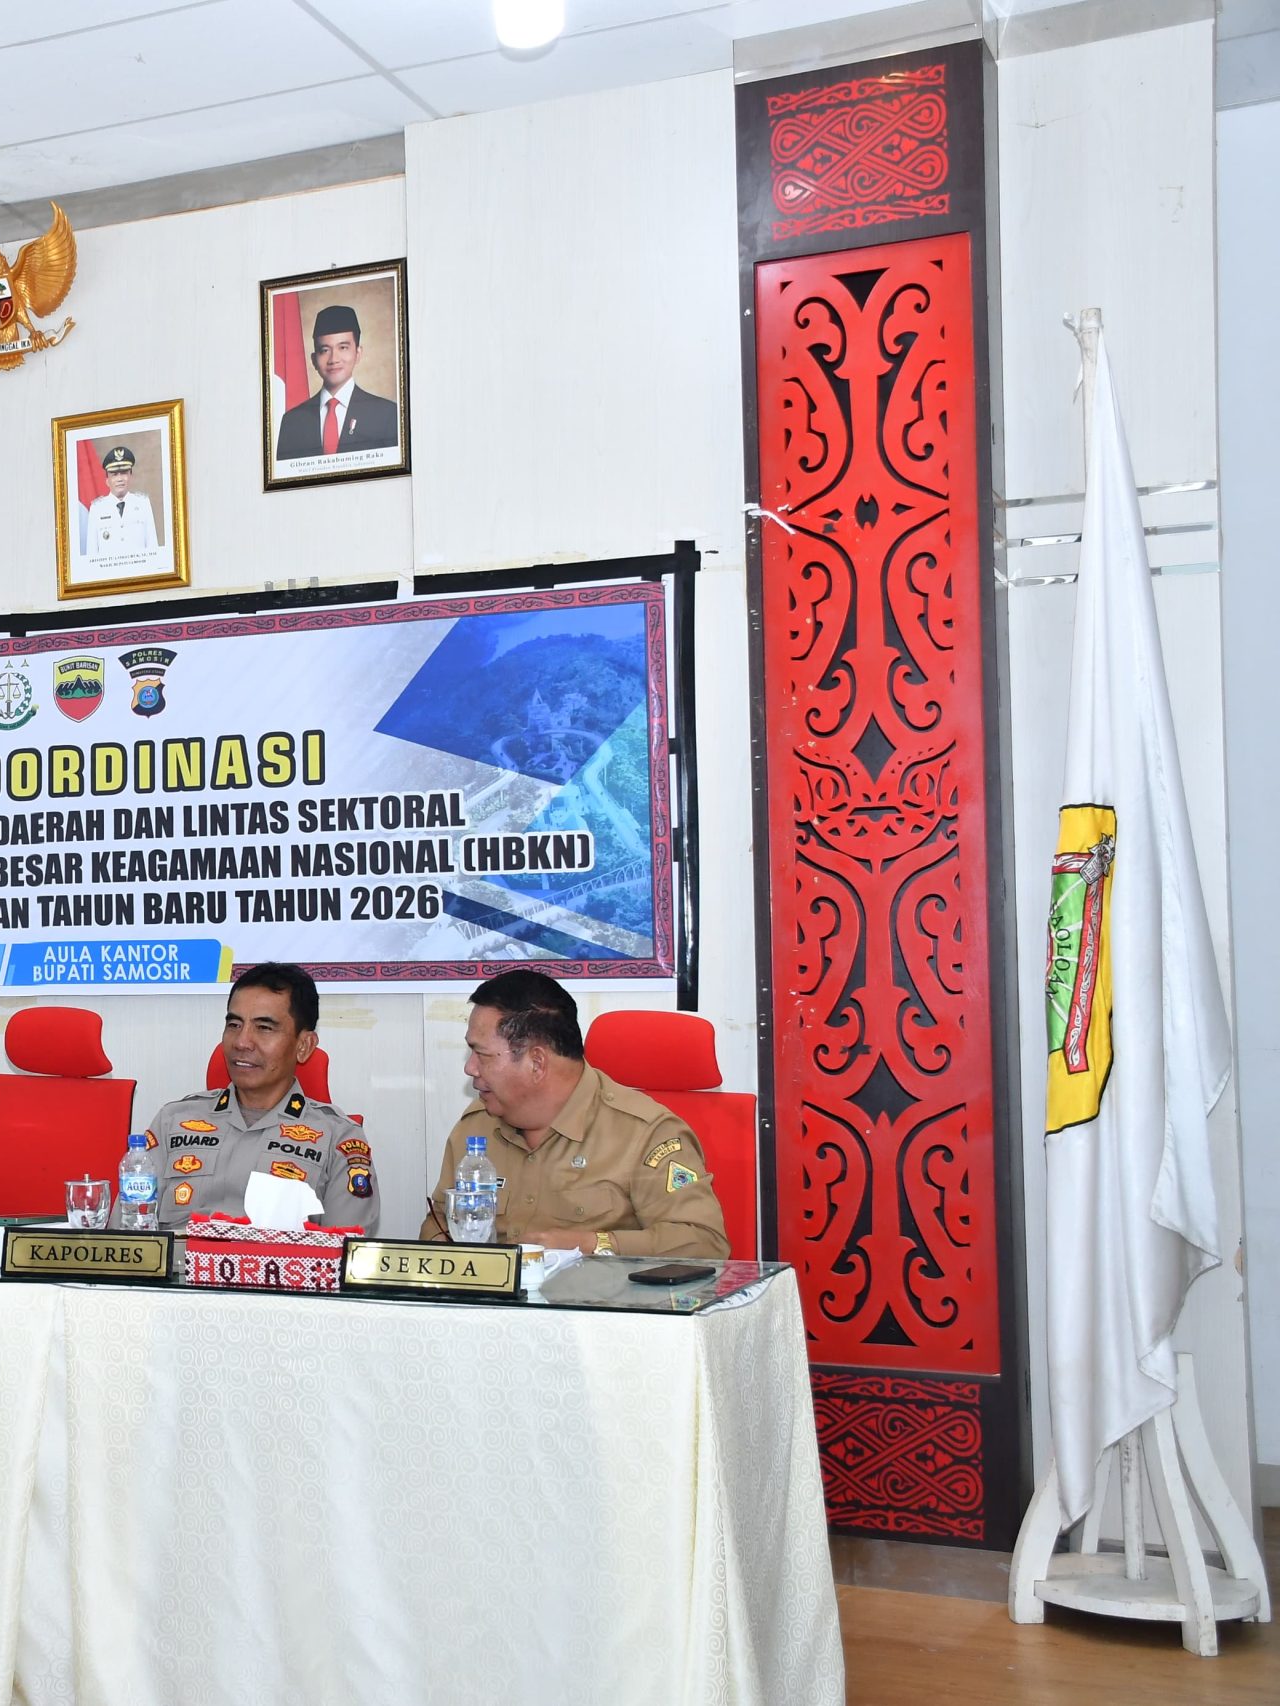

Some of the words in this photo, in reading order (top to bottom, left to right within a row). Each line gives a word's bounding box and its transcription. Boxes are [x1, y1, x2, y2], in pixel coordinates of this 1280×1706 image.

[290, 460, 316, 469] Gibran
[317, 454, 365, 466] Rakabuming
[366, 451, 384, 459] Raka
[125, 656, 170, 668] SAMOSIR
[132, 649, 163, 659] POLRES
[76, 661, 99, 671] BARISAN
[113, 805, 174, 841] DAN
[182, 799, 290, 838] LINTAS
[298, 792, 466, 834] SEKTORAL
[91, 845, 282, 884] KEAGAMAAN
[290, 838, 455, 878] NASIONAL
[463, 833, 592, 872] (HBKN)
[36, 893, 135, 927] TAHUN
[143, 890, 227, 925] BARU
[235, 887, 341, 923] TAHUN
[349, 884, 440, 920] 2026
[43, 945, 92, 963] AULA
[100, 943, 179, 963] KANTOR
[32, 964, 95, 982] BUPATI
[102, 962, 191, 981] SAMOSIR
[170, 1135, 220, 1149] EDUARD
[267, 1141, 322, 1163] POLRI
[127, 1181, 152, 1193] AQUA
[29, 1244, 144, 1264] KAPOLRES
[193, 1254, 307, 1288] HORAS
[379, 1255, 478, 1277] SEKDA
